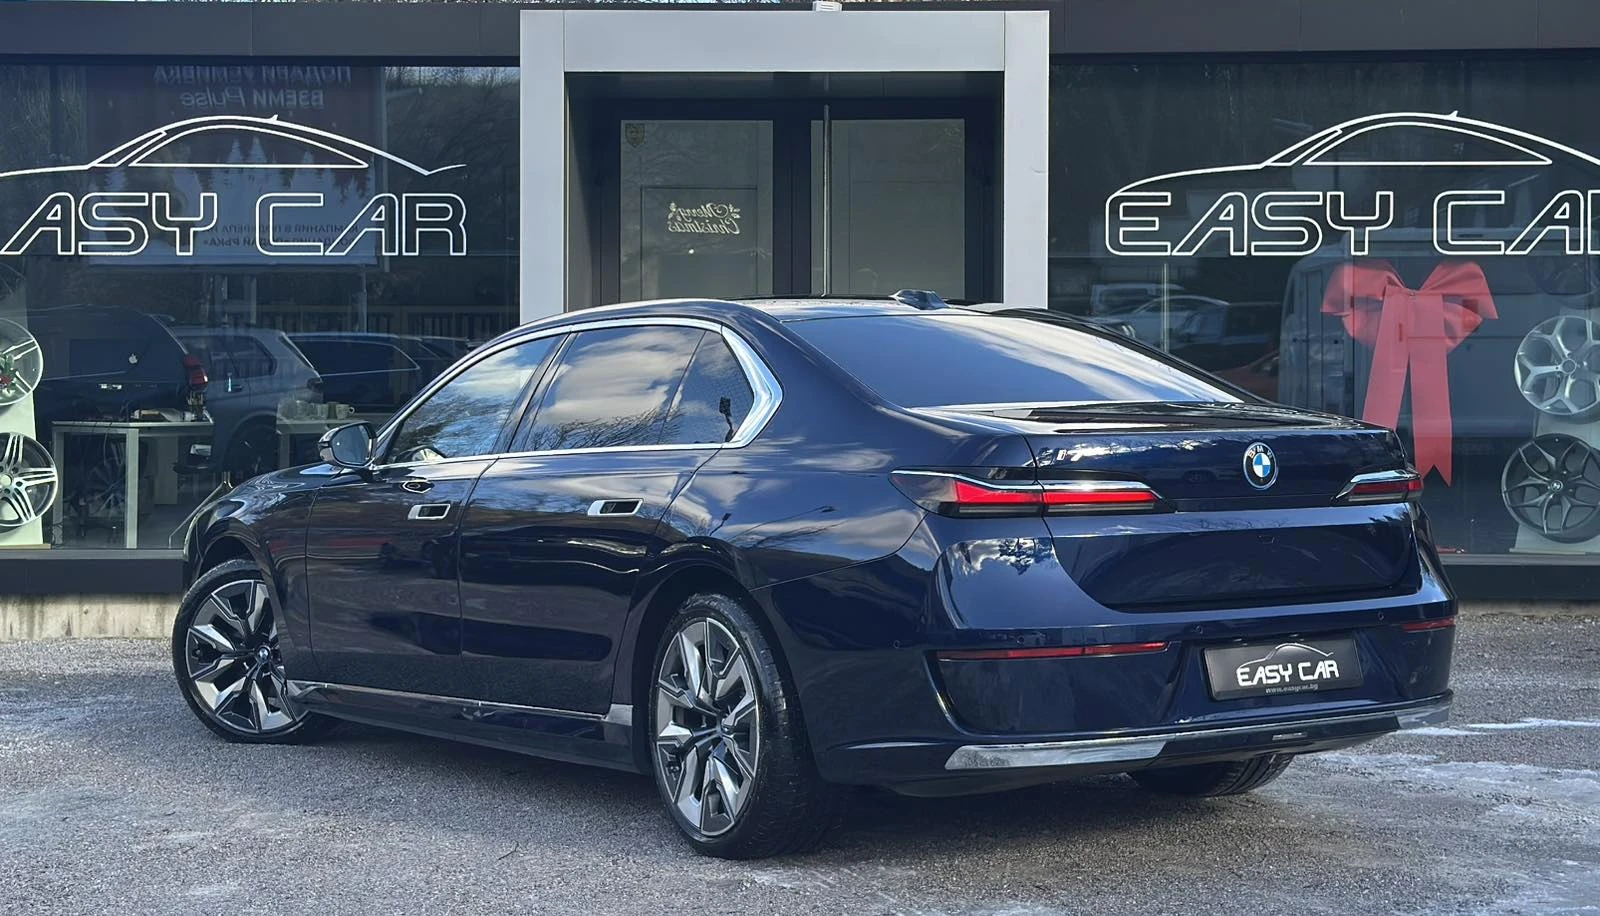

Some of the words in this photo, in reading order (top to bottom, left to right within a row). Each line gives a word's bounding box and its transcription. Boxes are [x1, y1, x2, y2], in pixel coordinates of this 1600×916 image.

[255, 191, 467, 256] CAR
[1105, 190, 1394, 256] EASY
[1247, 445, 1273, 459] BMW
[1236, 663, 1293, 687] EASY
[1298, 660, 1340, 681] CAR
